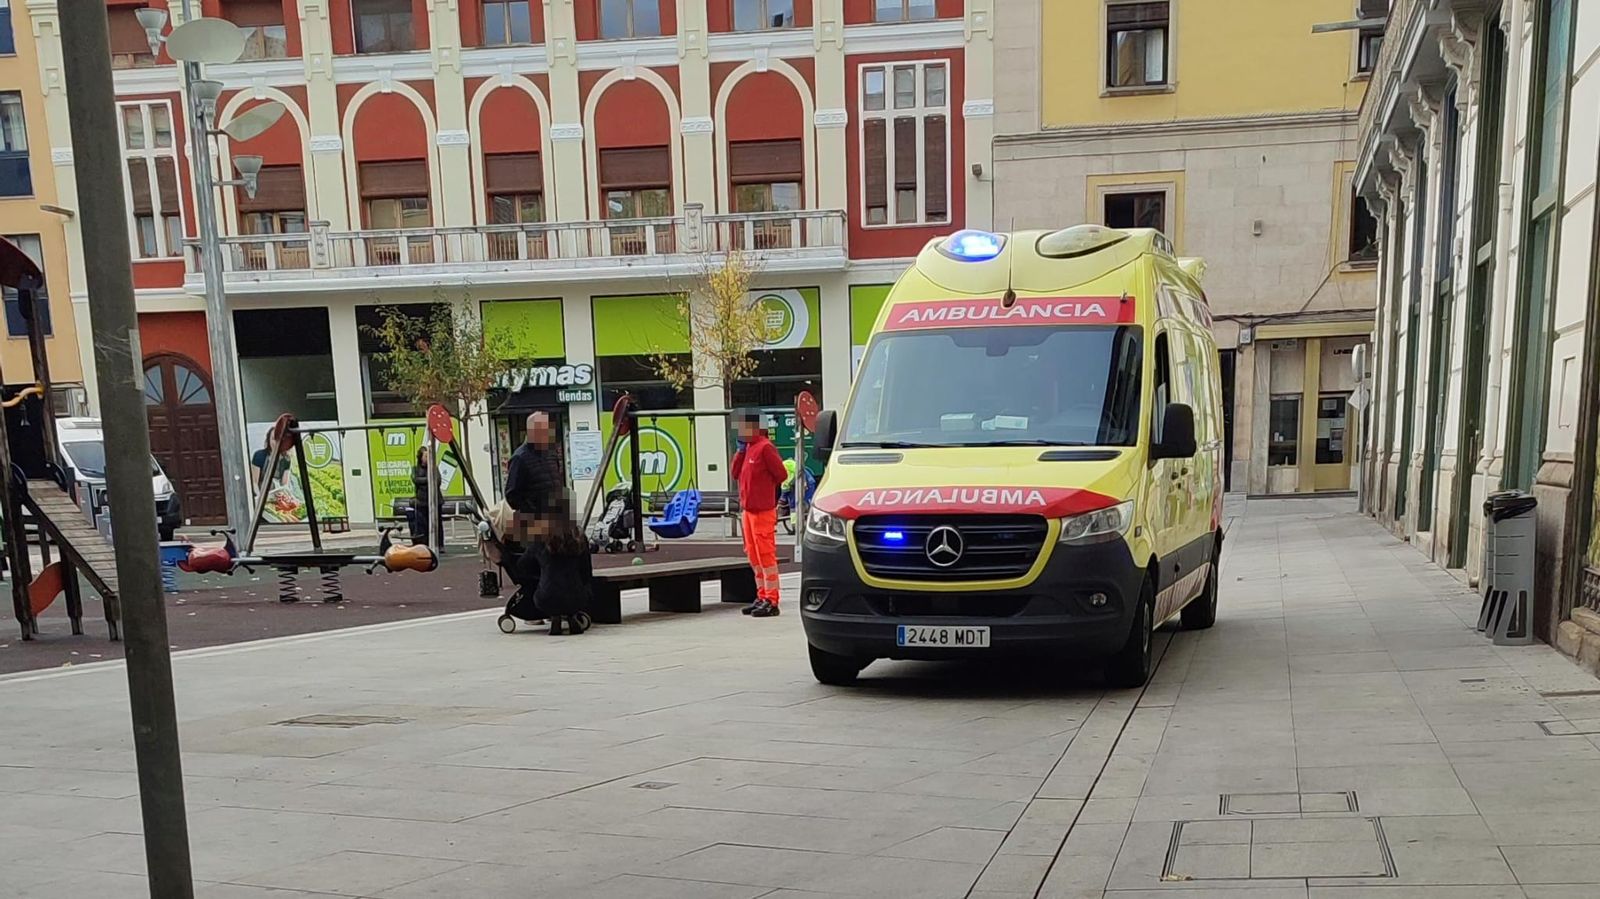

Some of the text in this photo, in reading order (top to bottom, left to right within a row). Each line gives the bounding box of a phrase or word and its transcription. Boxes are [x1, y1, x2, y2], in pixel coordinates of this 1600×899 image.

[899, 303, 1106, 323] AMBULANCIA
[559, 390, 592, 402] tiendas
[908, 628, 986, 645] 2448 MDT
